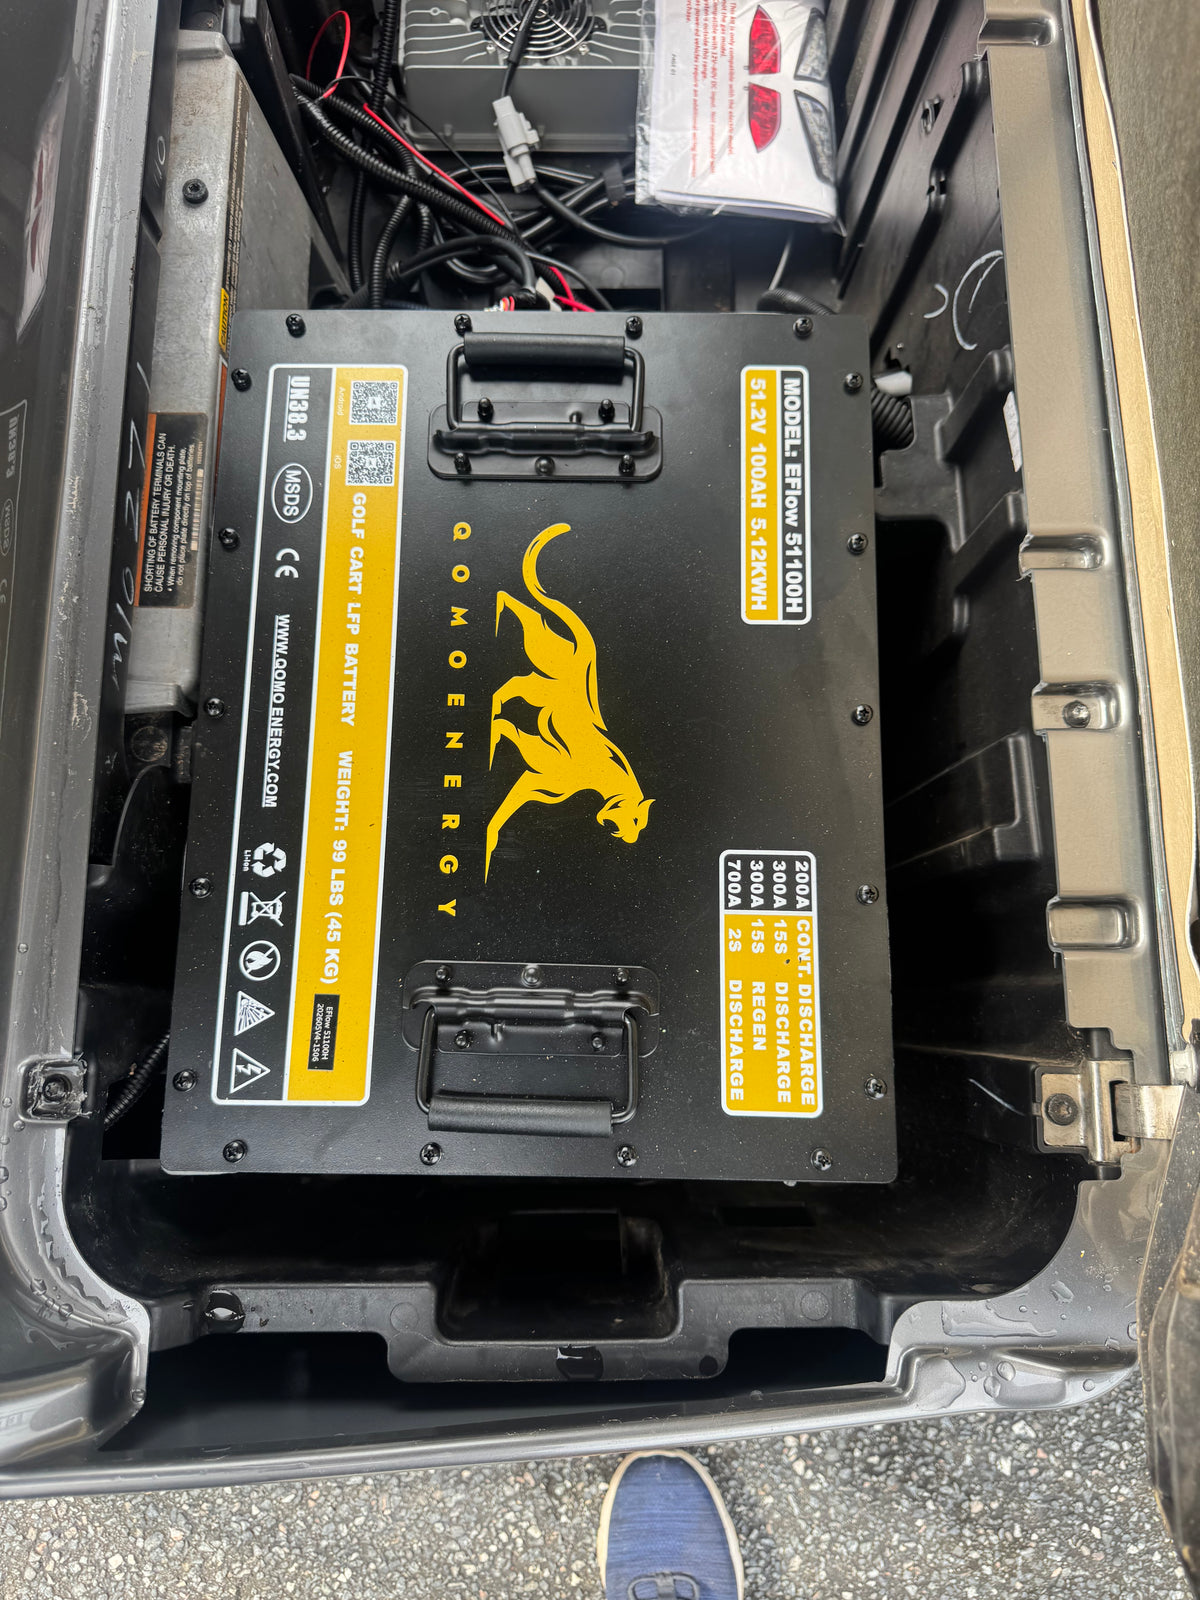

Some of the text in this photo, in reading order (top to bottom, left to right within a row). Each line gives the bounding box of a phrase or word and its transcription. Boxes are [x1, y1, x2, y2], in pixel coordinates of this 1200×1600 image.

[219, 293, 230, 346] CAUTION
[286, 376, 310, 442] UN38.3
[337, 387, 347, 416] Android
[187, 443, 196, 472] batteries.
[334, 455, 342, 470] iOS
[175, 466, 186, 496] mounting
[184, 493, 191, 502] on
[185, 481, 193, 491] top
[282, 469, 302, 517] MSDS
[750, 378, 768, 610] 51.2V 100AH 5.12KWH
[784, 378, 803, 614] MODEL: EFlow 51100H
[144, 433, 167, 592] SHORTING OF BATTERY TERMINALS CAN
[154, 444, 176, 592] CAUSE PERSONAL INJURY OR DEATH.
[173, 497, 182, 533] component
[181, 502, 191, 526] directly
[170, 534, 180, 564] removing
[178, 545, 187, 563] place
[180, 528, 188, 544] plate
[167, 566, 176, 586] When
[176, 576, 184, 586] do
[274, 548, 300, 579] CE
[320, 492, 367, 984] GOLF CART LFP BATTERY WEIGHT: 99 LBS (45 KG)
[750, 860, 766, 1051] 300A 15S REGEN
[727, 860, 744, 1101] 700A 2S DISCHARGE
[772, 860, 791, 1103] 300A 15S DISCHARGE
[795, 860, 815, 1105] 200A CONT. DISCHARGE
[321, 1006, 334, 1060] EFlow 51100H
